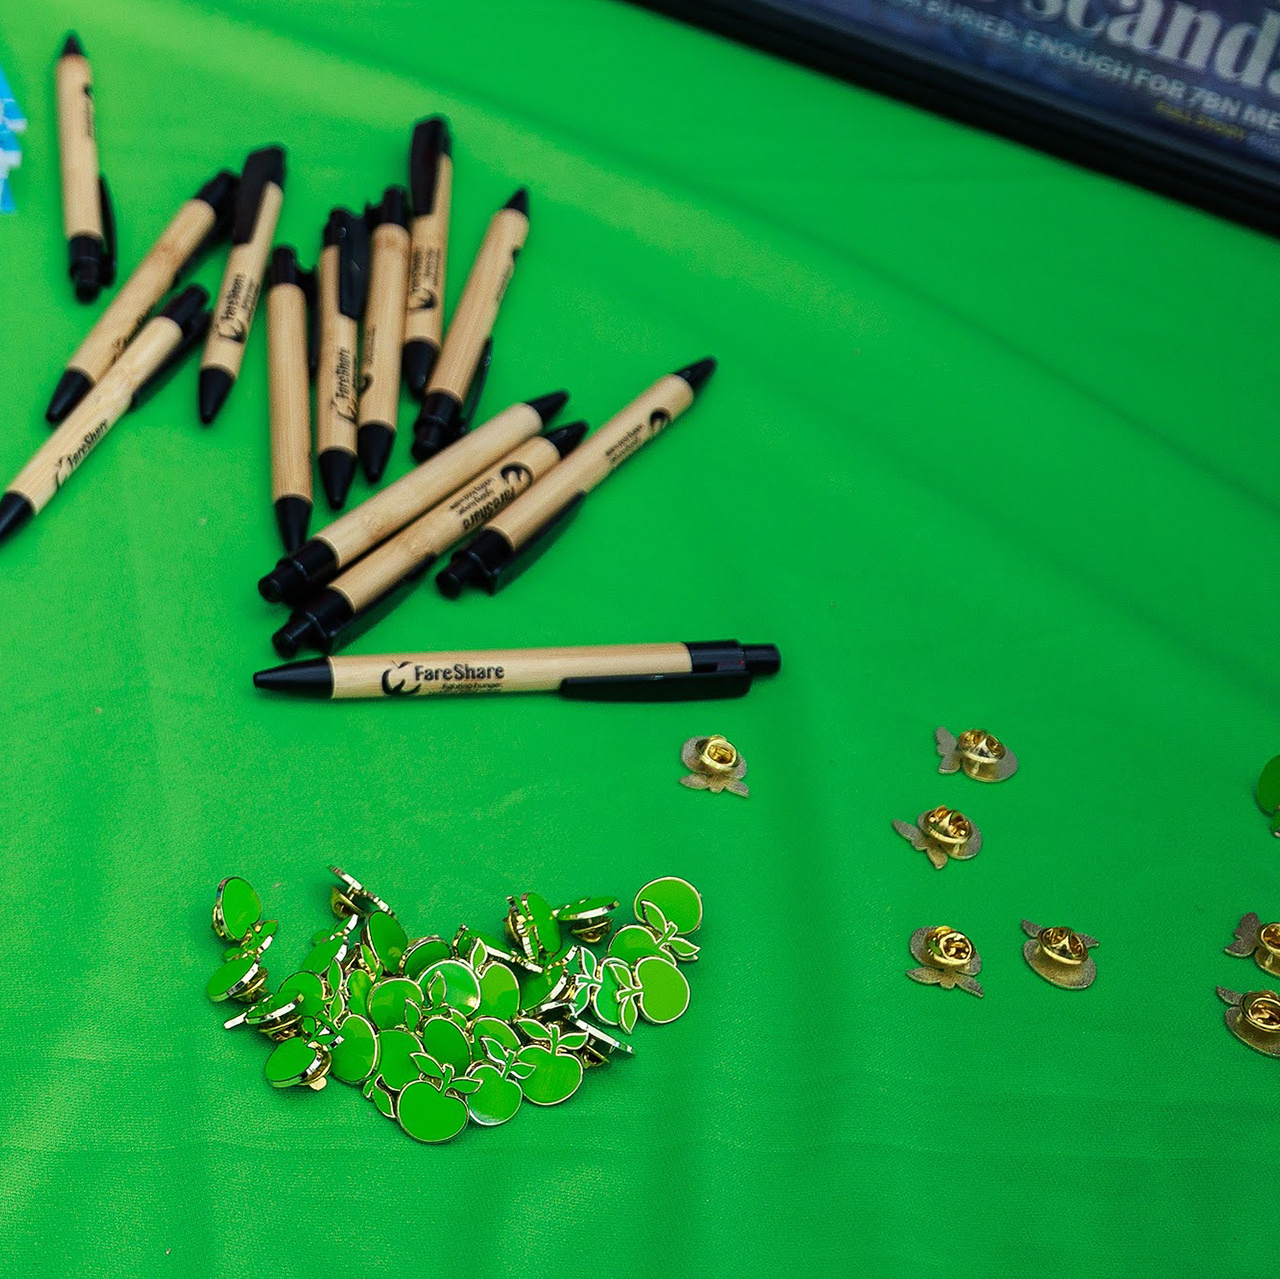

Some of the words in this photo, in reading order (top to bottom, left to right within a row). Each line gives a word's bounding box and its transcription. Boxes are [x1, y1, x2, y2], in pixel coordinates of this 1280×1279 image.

[1024, 30, 1132, 81] ENOUGH
[1132, 66, 1188, 100] FOR
[414, 663, 505, 681] FareShare
